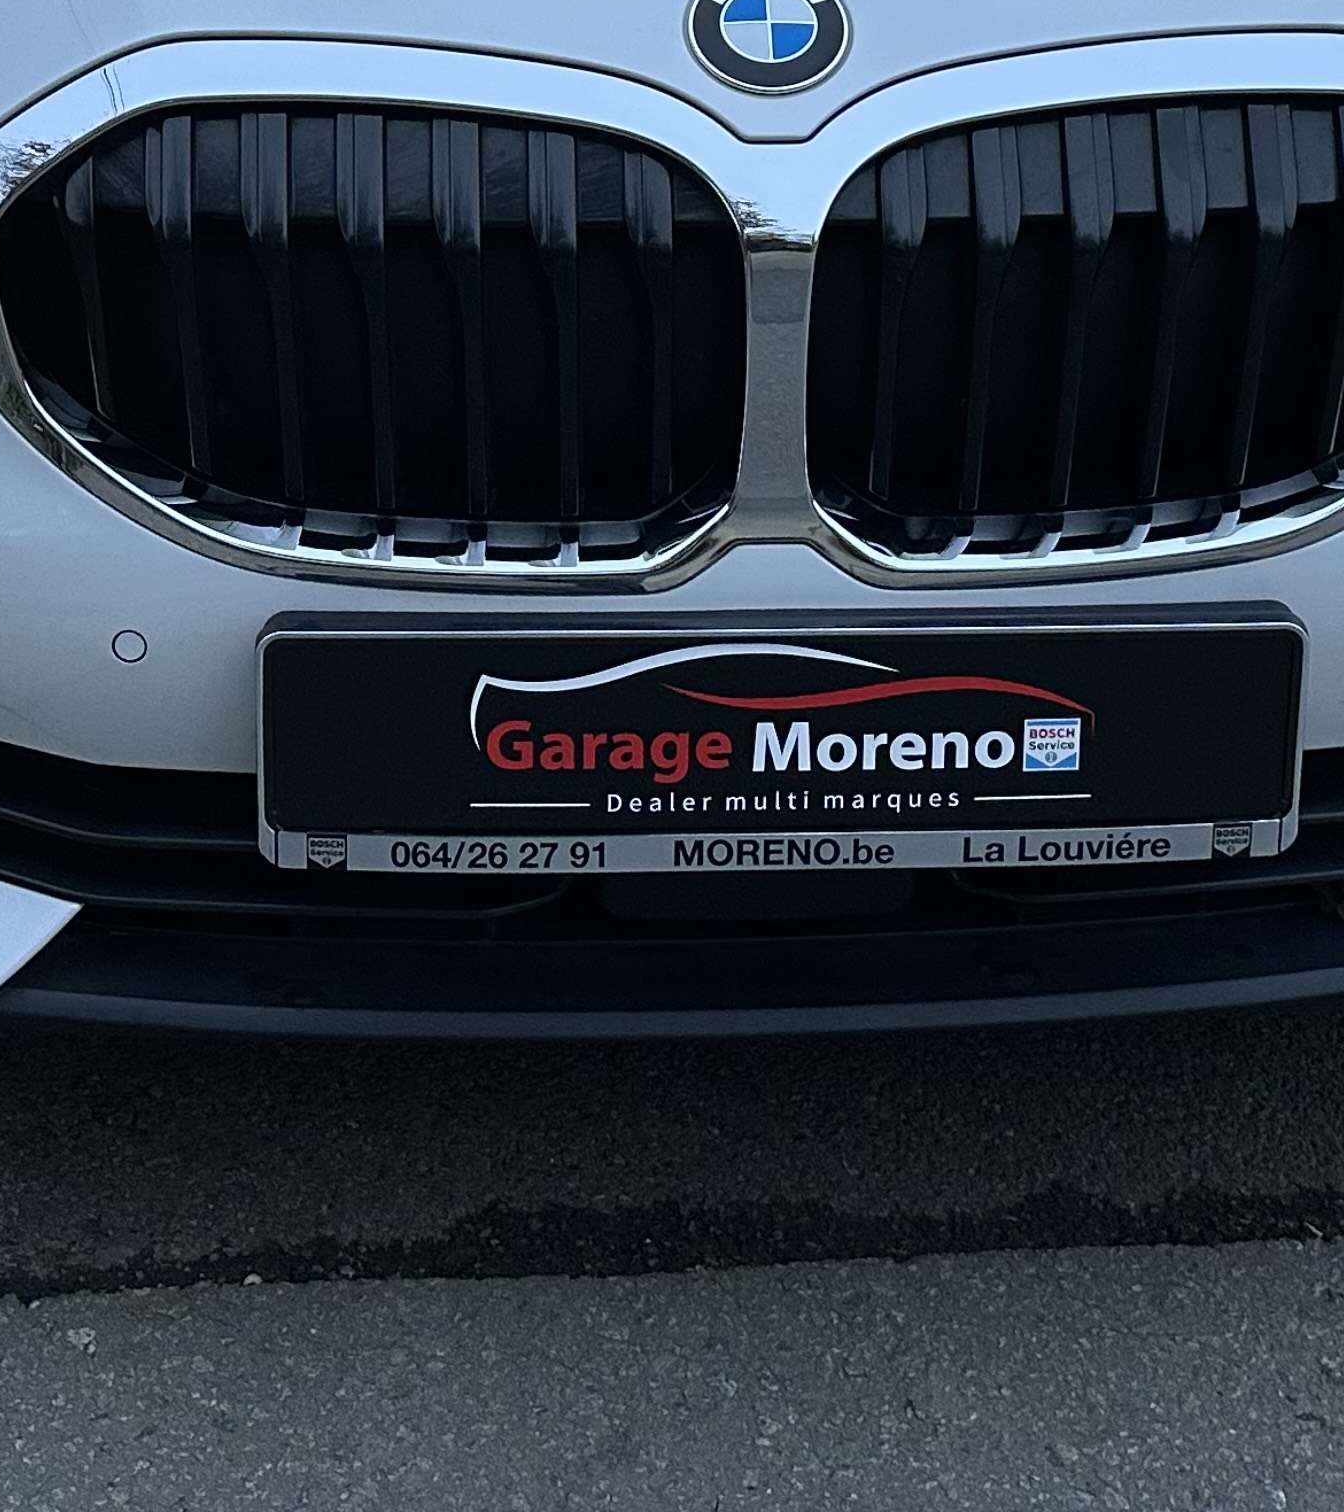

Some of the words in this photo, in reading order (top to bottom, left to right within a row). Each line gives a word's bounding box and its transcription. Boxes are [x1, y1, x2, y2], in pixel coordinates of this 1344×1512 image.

[1028, 740, 1075, 751] Service
[1029, 728, 1075, 739] BOSCH
[486, 720, 733, 784] Garage
[752, 721, 1015, 772] Moreno
[607, 792, 713, 813] Dealer
[725, 791, 809, 811] multi
[824, 792, 960, 813] marques
[390, 841, 508, 869] 064/26
[519, 842, 558, 869] 27
[570, 842, 606, 868] 91
[673, 838, 895, 866] MORENO.be
[962, 837, 1005, 863] La
[1017, 832, 1171, 862] Louviére
